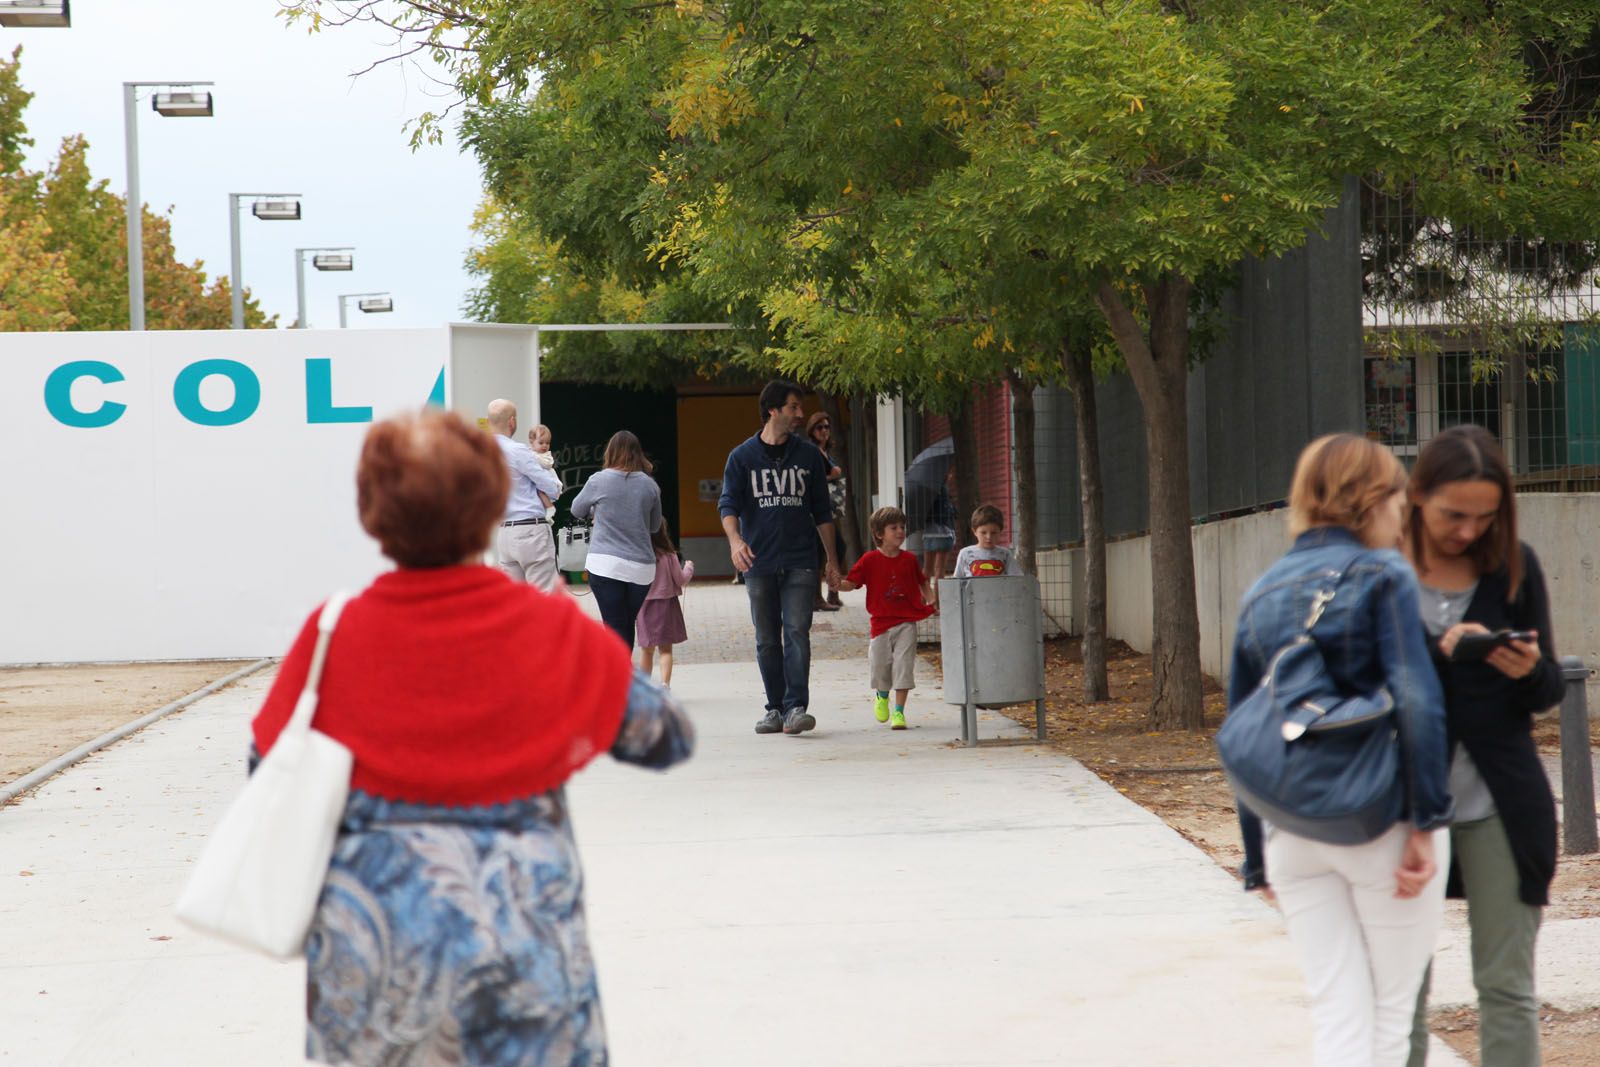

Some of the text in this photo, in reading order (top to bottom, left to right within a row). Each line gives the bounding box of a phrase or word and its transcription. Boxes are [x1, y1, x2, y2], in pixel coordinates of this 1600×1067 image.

[44, 358, 446, 429] COL
[751, 465, 807, 498] LEVI'S
[759, 496, 803, 508] CALIFORNIA
